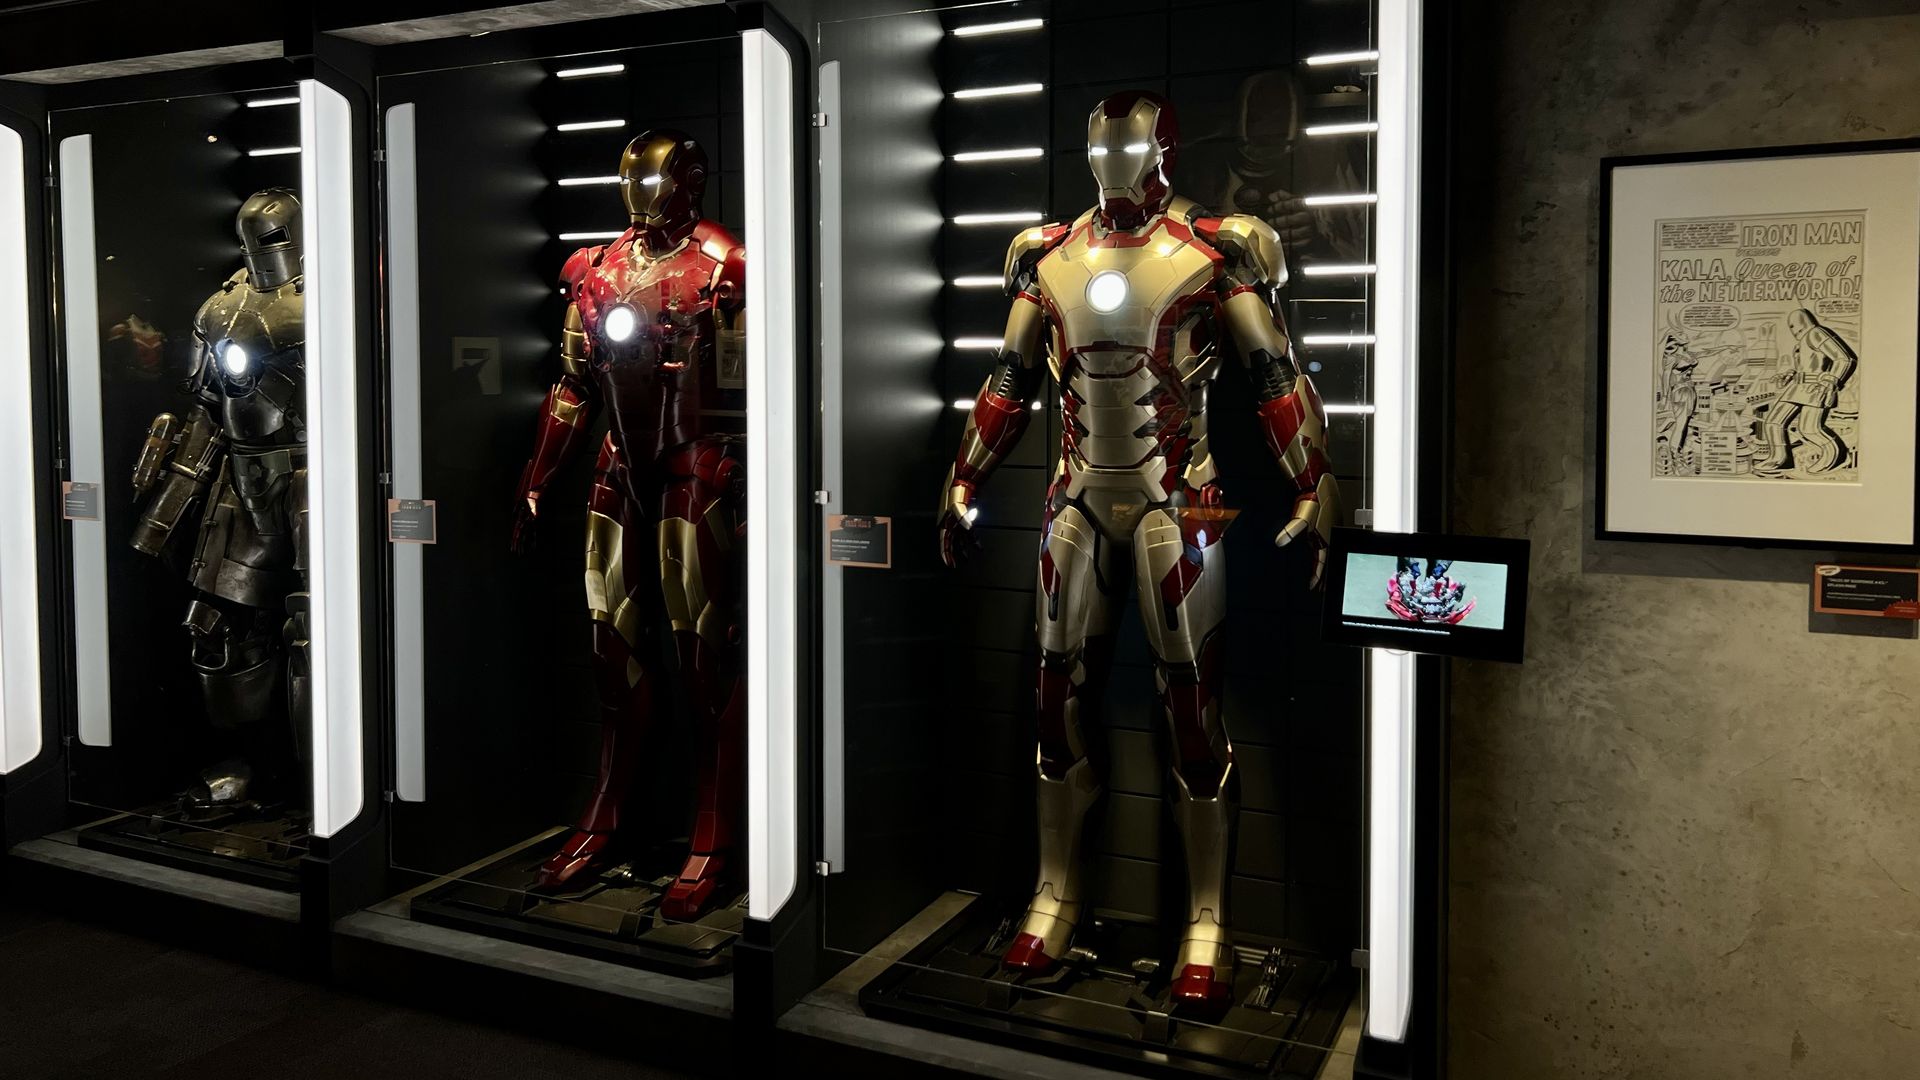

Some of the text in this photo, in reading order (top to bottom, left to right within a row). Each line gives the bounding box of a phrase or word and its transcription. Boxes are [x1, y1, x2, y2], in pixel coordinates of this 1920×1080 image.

[1742, 225, 1797, 248] IRON
[1804, 221, 1861, 245] MAN
[1733, 256, 1817, 281] Queen
[1825, 255, 1857, 277] of
[1660, 275, 1862, 303] the NETHERWORLD!
